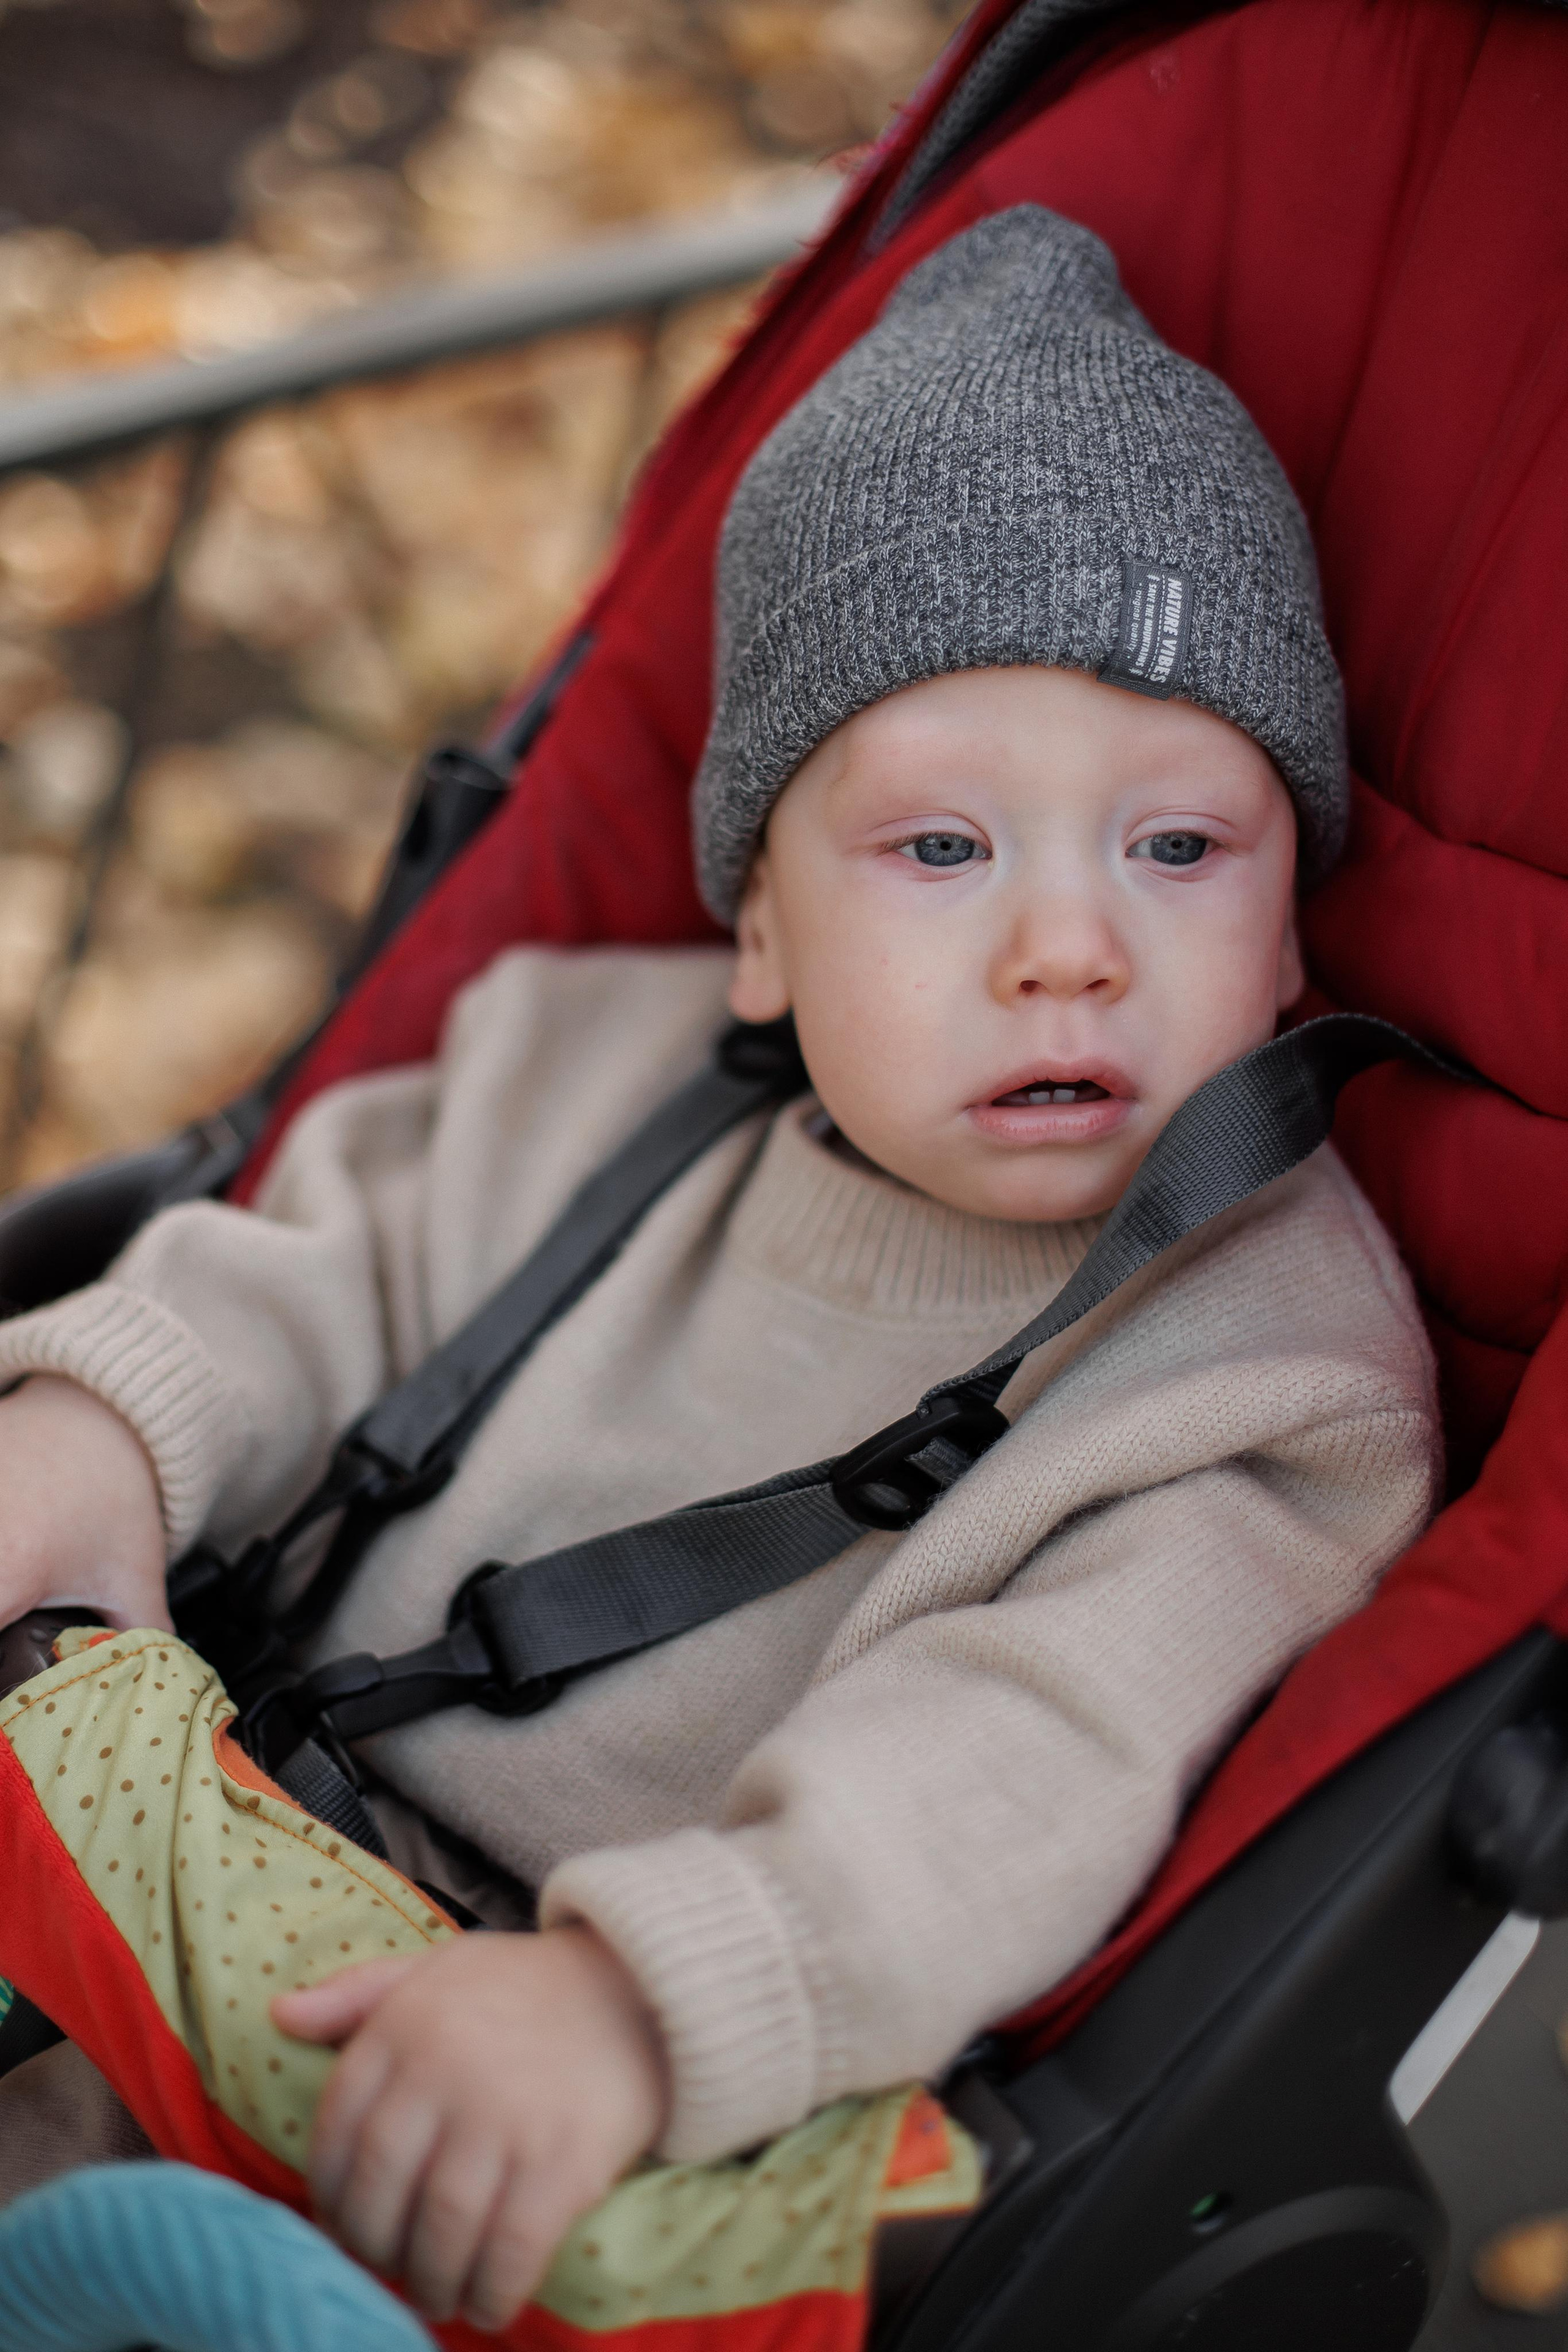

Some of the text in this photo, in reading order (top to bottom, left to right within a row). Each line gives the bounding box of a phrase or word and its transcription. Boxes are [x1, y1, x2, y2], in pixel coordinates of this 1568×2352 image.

[1126, 622, 1139, 652] quality
[1135, 583, 1157, 667] SAVE THE MOUNTAINS
[1150, 578, 1182, 683] NATURE VIBES
